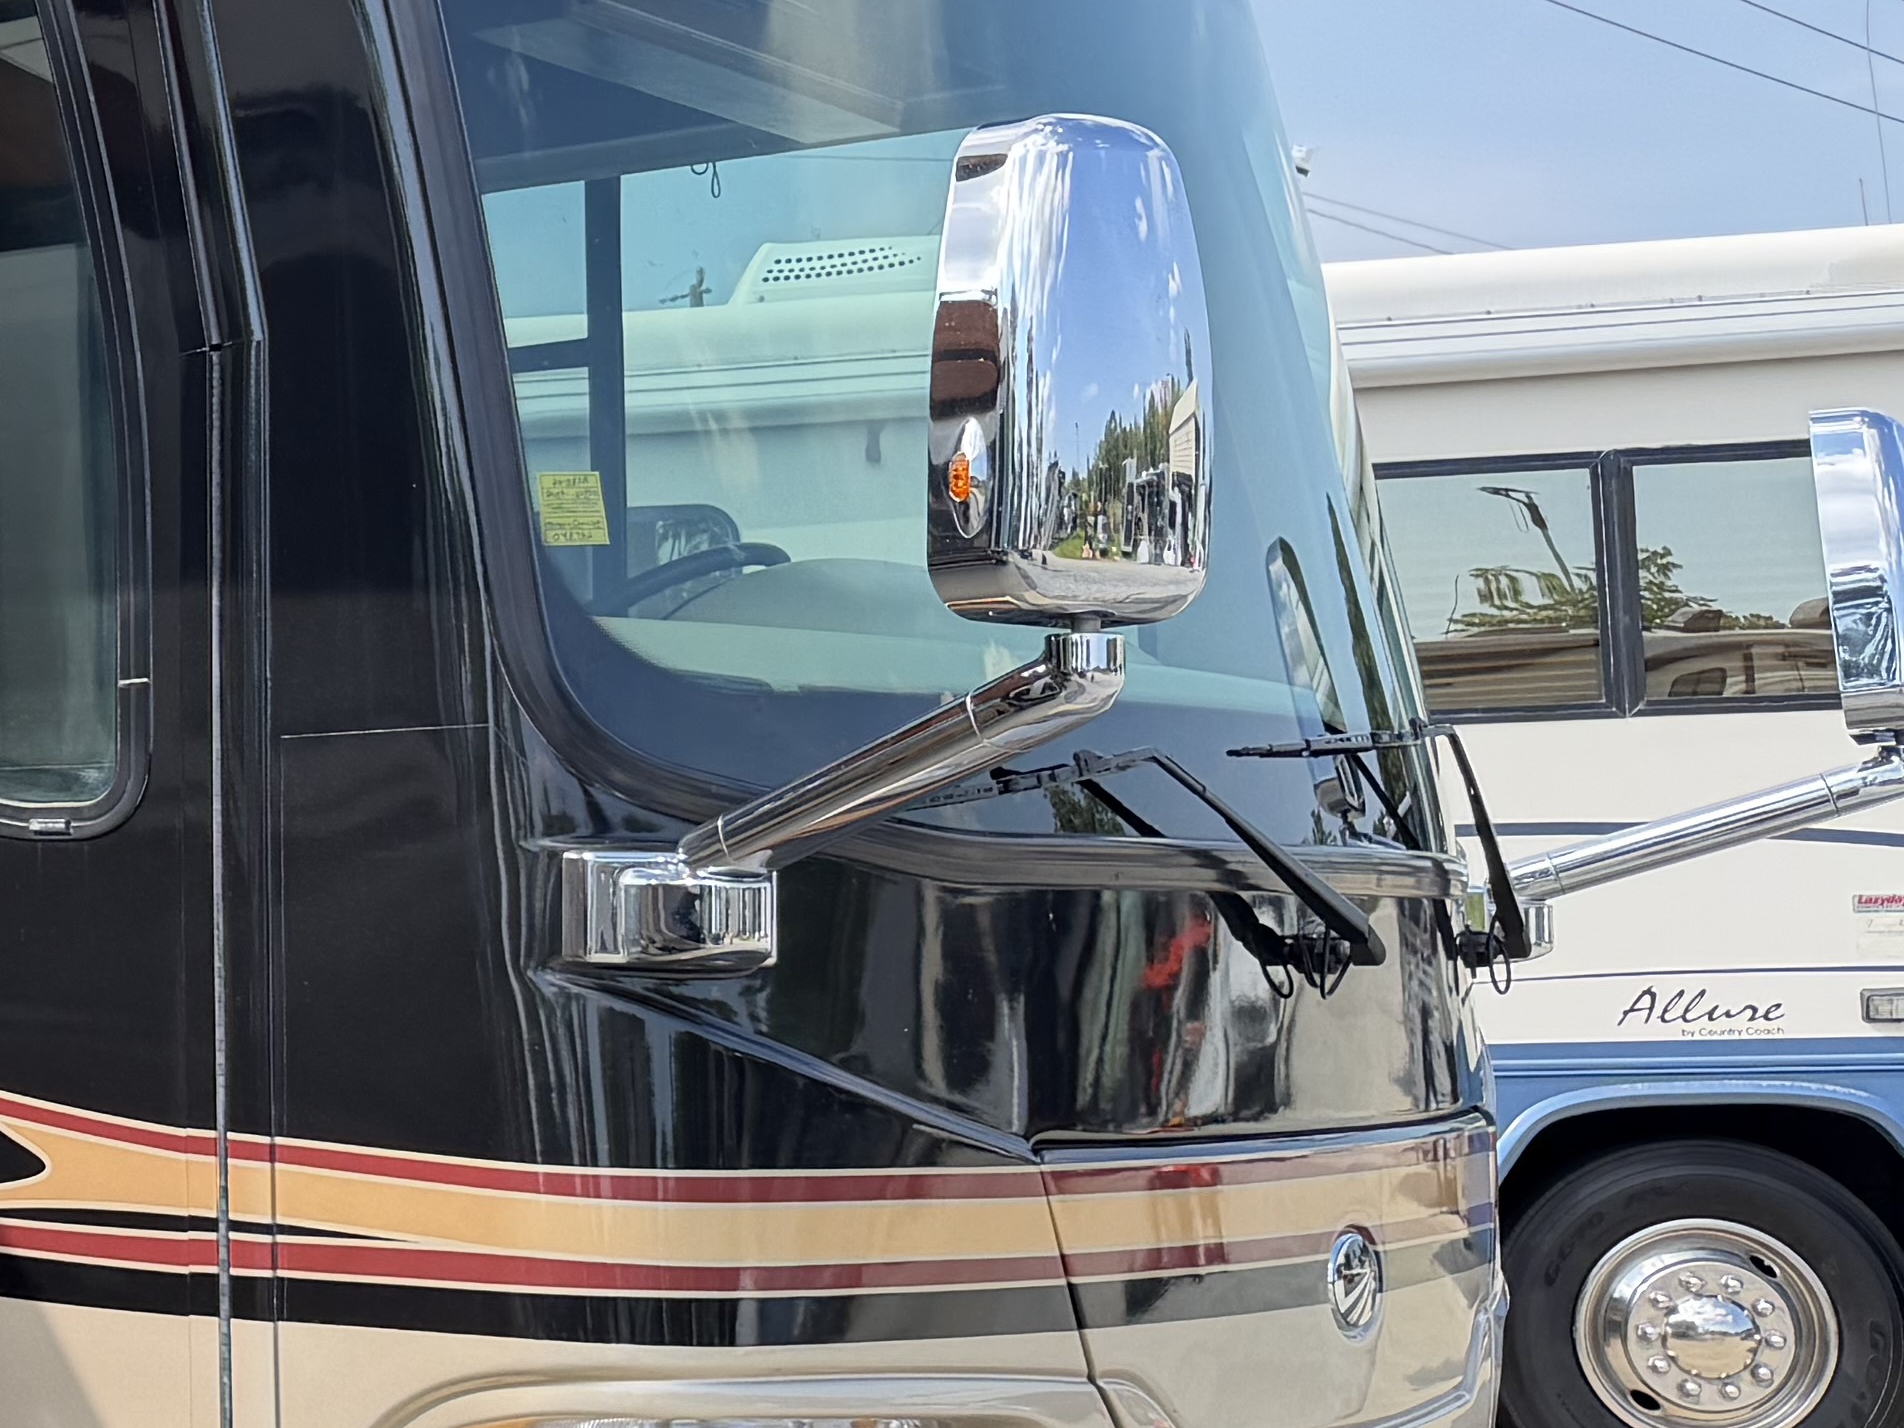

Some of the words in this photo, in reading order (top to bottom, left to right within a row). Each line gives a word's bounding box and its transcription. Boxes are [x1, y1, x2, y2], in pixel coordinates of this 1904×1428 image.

[1617, 985, 1785, 1026] Allure
[1681, 1029, 1695, 1037] by
[1698, 1027, 1743, 1037] Country
[1745, 1026, 1785, 1036] Coach
